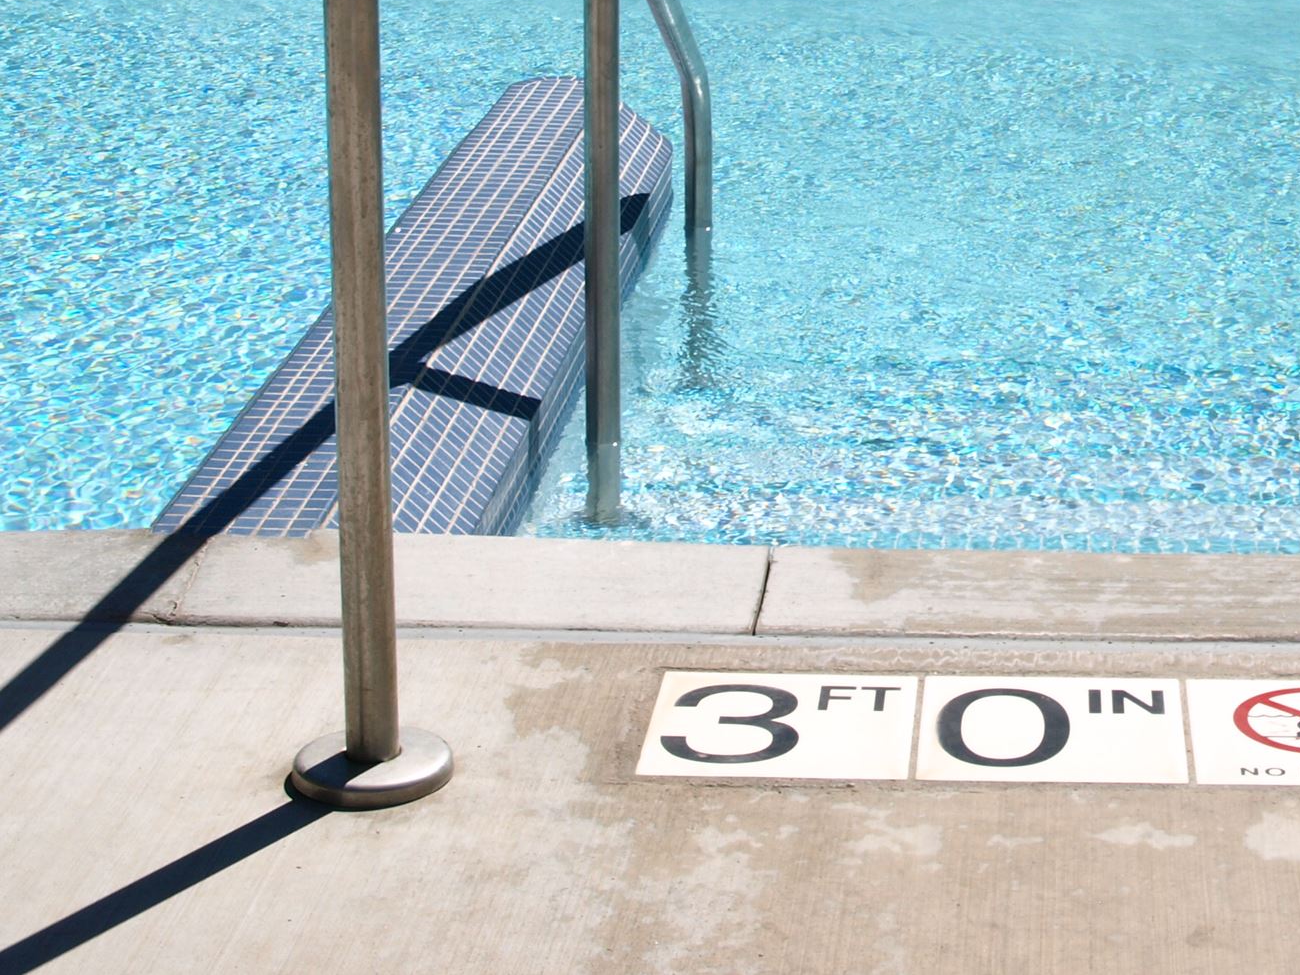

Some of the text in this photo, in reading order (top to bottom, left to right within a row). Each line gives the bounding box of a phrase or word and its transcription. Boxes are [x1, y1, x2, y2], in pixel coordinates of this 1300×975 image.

[660, 683, 1165, 767] 3 FT 0 IN
[1240, 767, 1286, 777] NO
